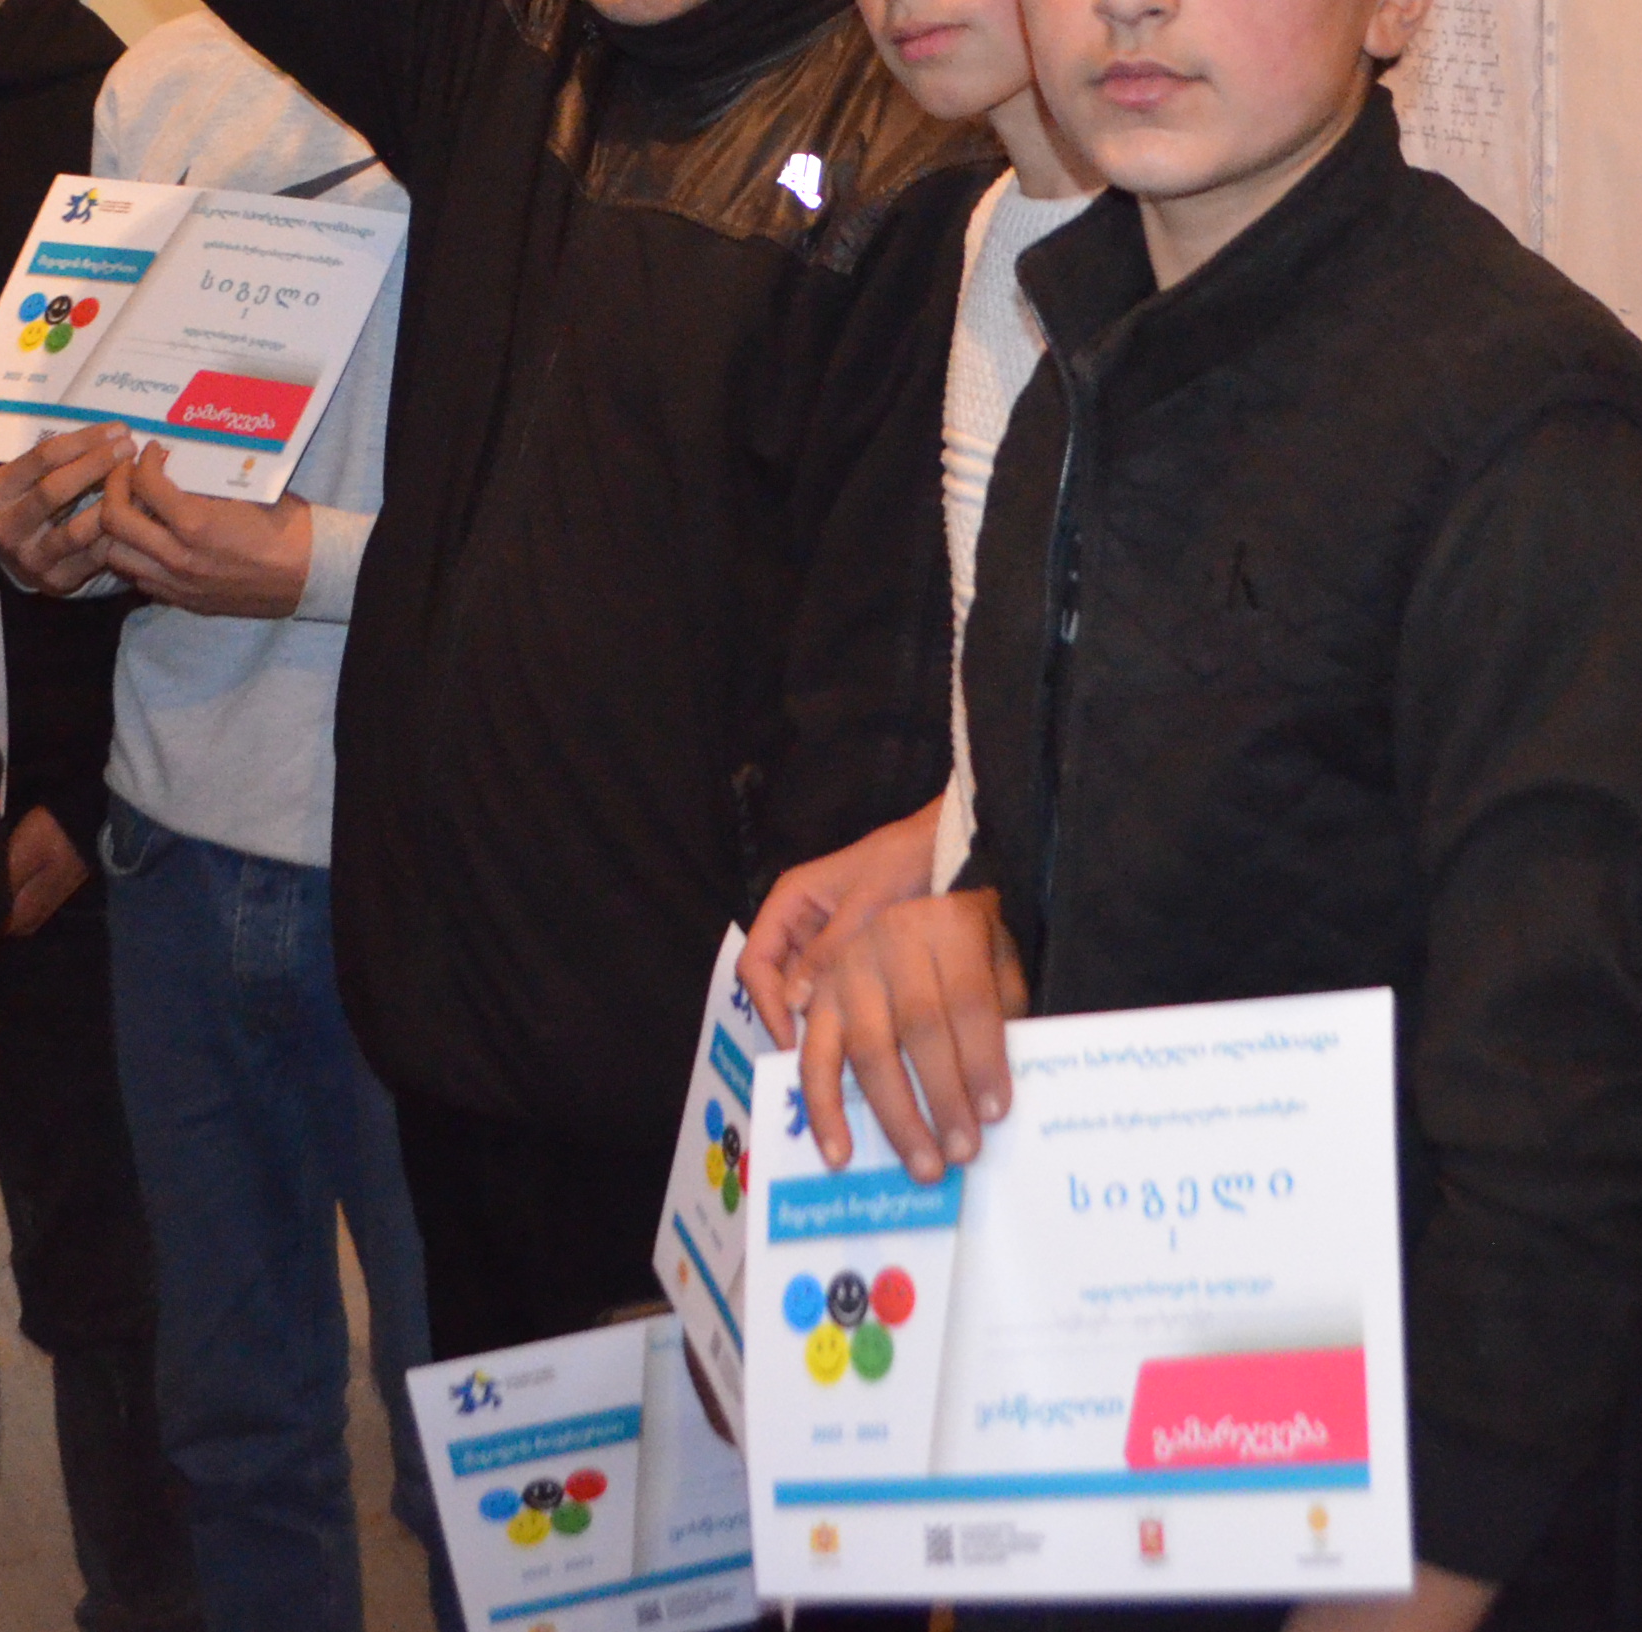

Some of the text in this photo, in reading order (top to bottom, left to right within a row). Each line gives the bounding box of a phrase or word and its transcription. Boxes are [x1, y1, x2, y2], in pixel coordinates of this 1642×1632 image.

[200, 269, 321, 309] სიგელი
[182, 404, 277, 433] გამარჯვება
[1067, 1168, 1295, 1221] სიგელი
[1151, 1410, 1331, 1461] გამარჯვება
